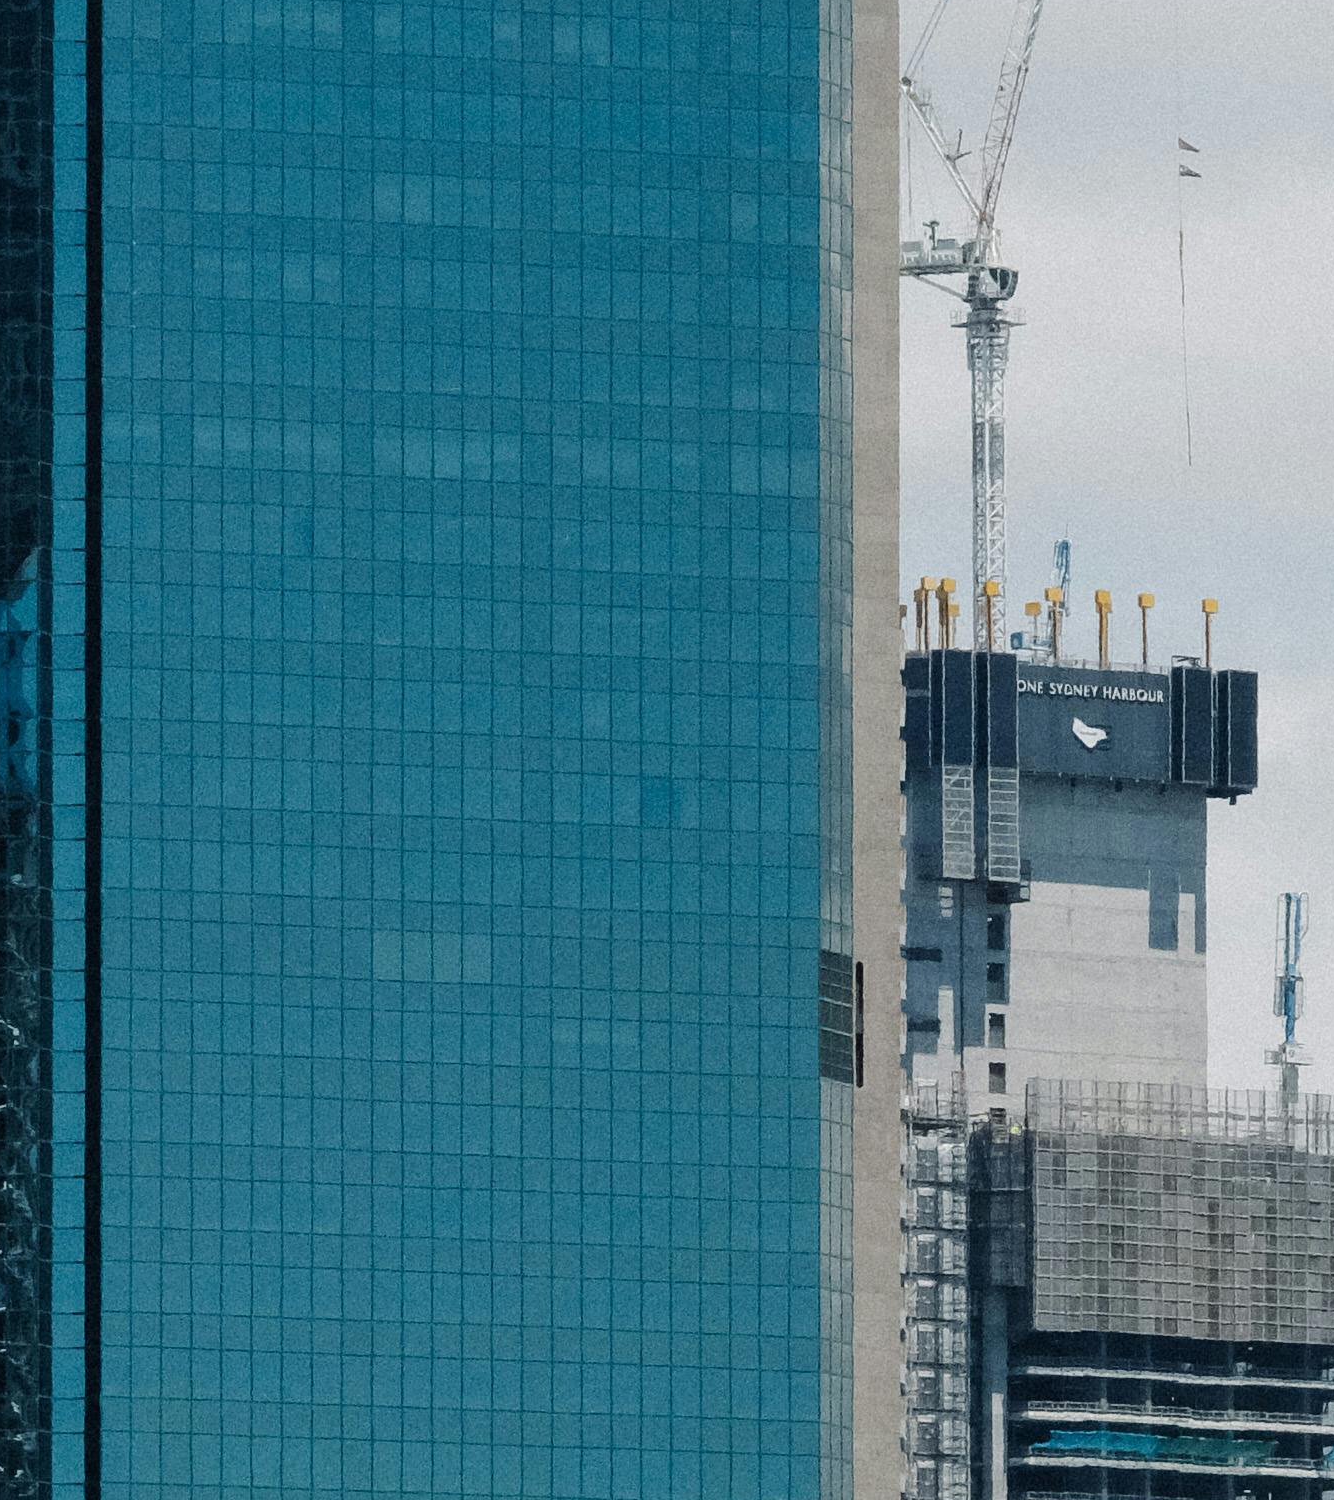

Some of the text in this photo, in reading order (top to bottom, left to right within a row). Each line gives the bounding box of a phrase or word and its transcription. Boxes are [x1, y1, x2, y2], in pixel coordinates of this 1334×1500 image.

[1017, 679, 1164, 703] ONE SYDNEY HARBOUR
